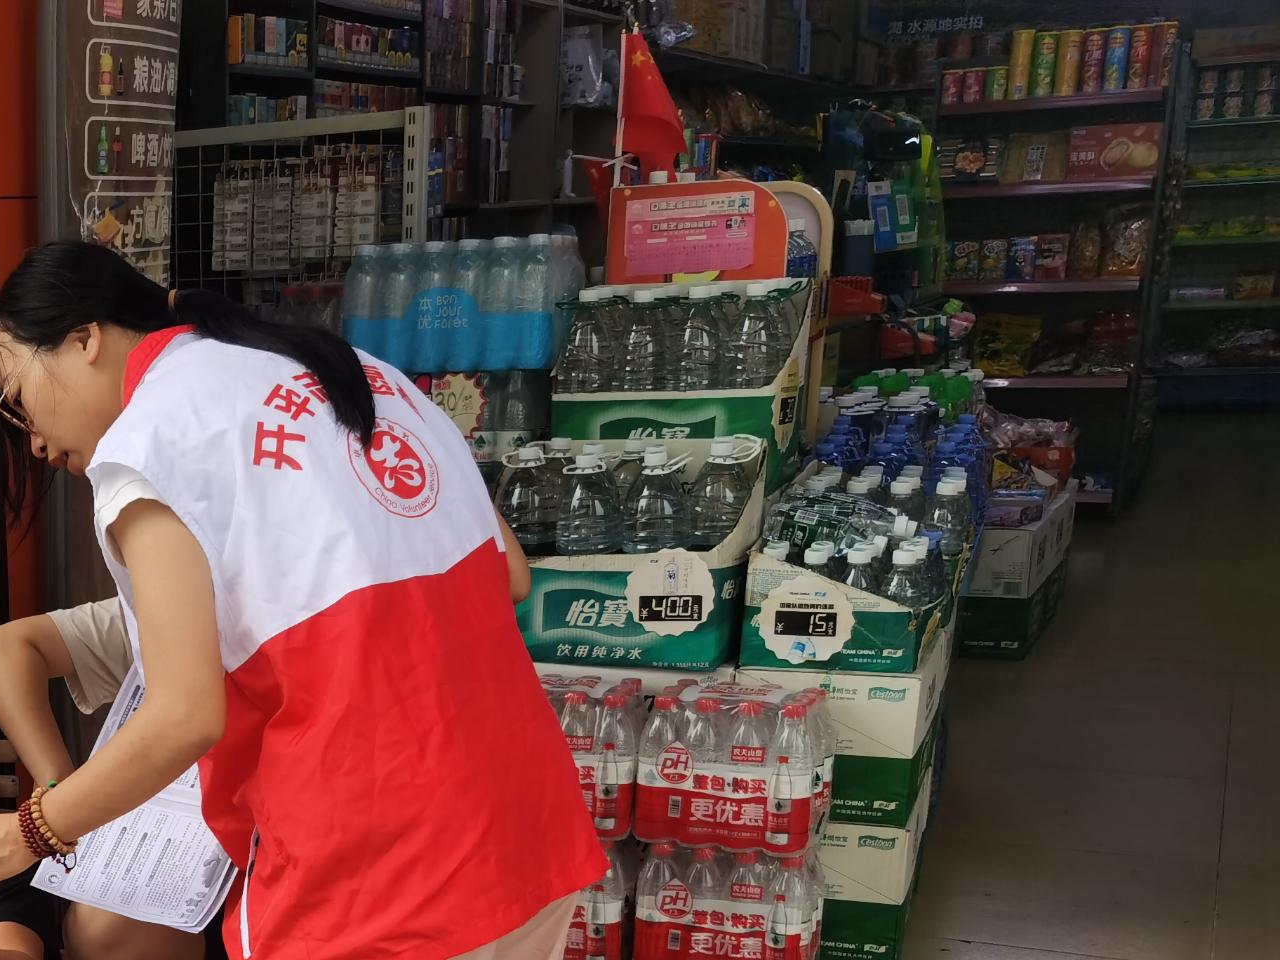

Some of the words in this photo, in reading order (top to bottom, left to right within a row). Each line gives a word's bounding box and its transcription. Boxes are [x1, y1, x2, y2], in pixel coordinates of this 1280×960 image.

[556, 643, 643, 661] 饮用纯净水
[689, 798, 765, 827] 更优惠
[689, 932, 763, 960] 更优惠
